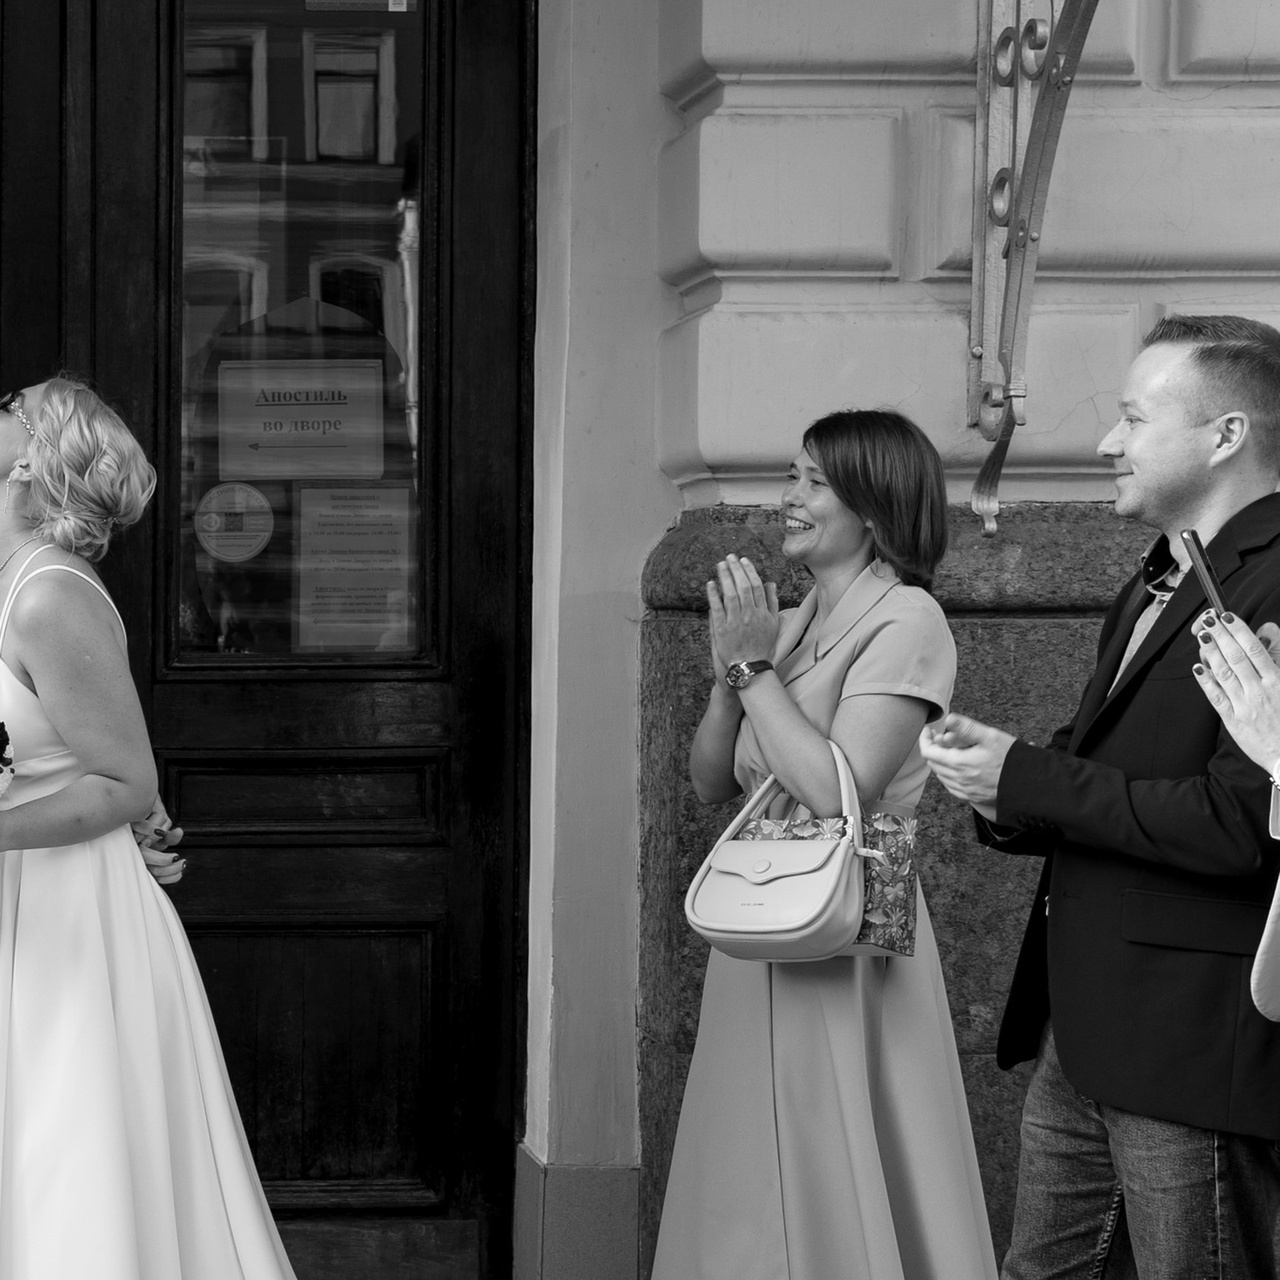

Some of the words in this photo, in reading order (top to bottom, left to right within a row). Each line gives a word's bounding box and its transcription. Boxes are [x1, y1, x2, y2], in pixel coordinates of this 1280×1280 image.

[255, 388, 348, 403] Апостиль
[262, 420, 283, 432] во
[288, 419, 342, 435] дворе
